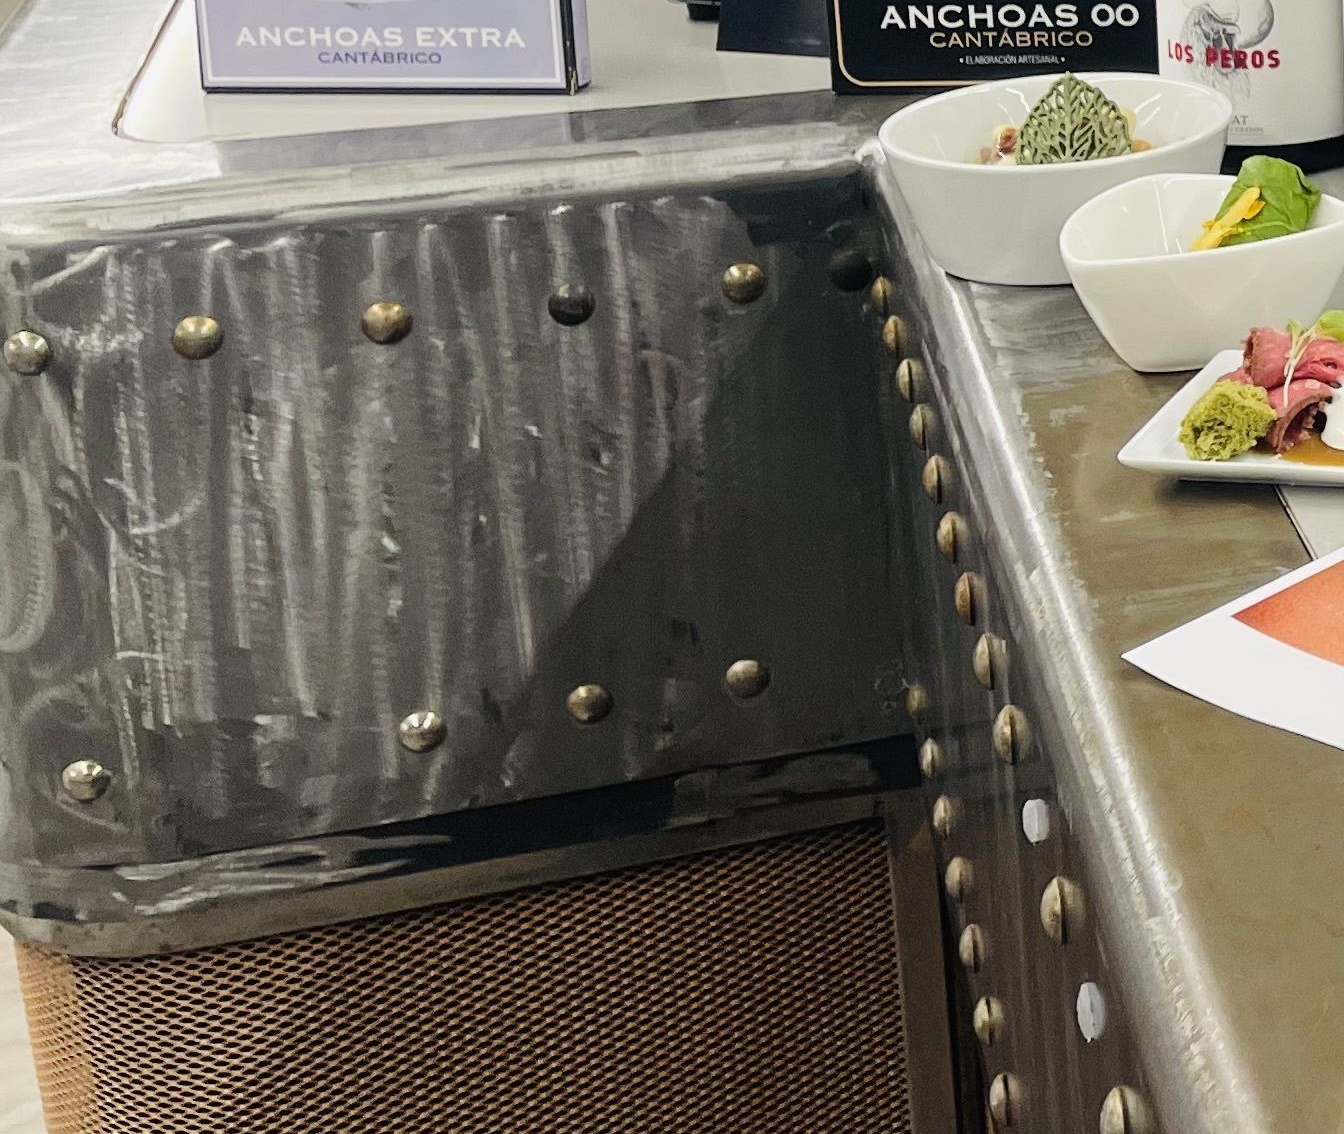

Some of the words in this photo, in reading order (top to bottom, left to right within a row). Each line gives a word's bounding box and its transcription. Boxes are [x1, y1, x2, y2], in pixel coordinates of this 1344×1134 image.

[880, 4, 1079, 30] ANCHOAS
[236, 27, 403, 47] ANCHOAS
[416, 27, 527, 49] EXTRA
[929, 28, 1093, 48] CANTÁBRICO
[318, 49, 442, 66] CANTÁBRICO
[1018, 54, 1060, 65] ARTESANAL
[1167, 39, 1195, 64] LOS
[1205, 46, 1281, 70] PEROS
